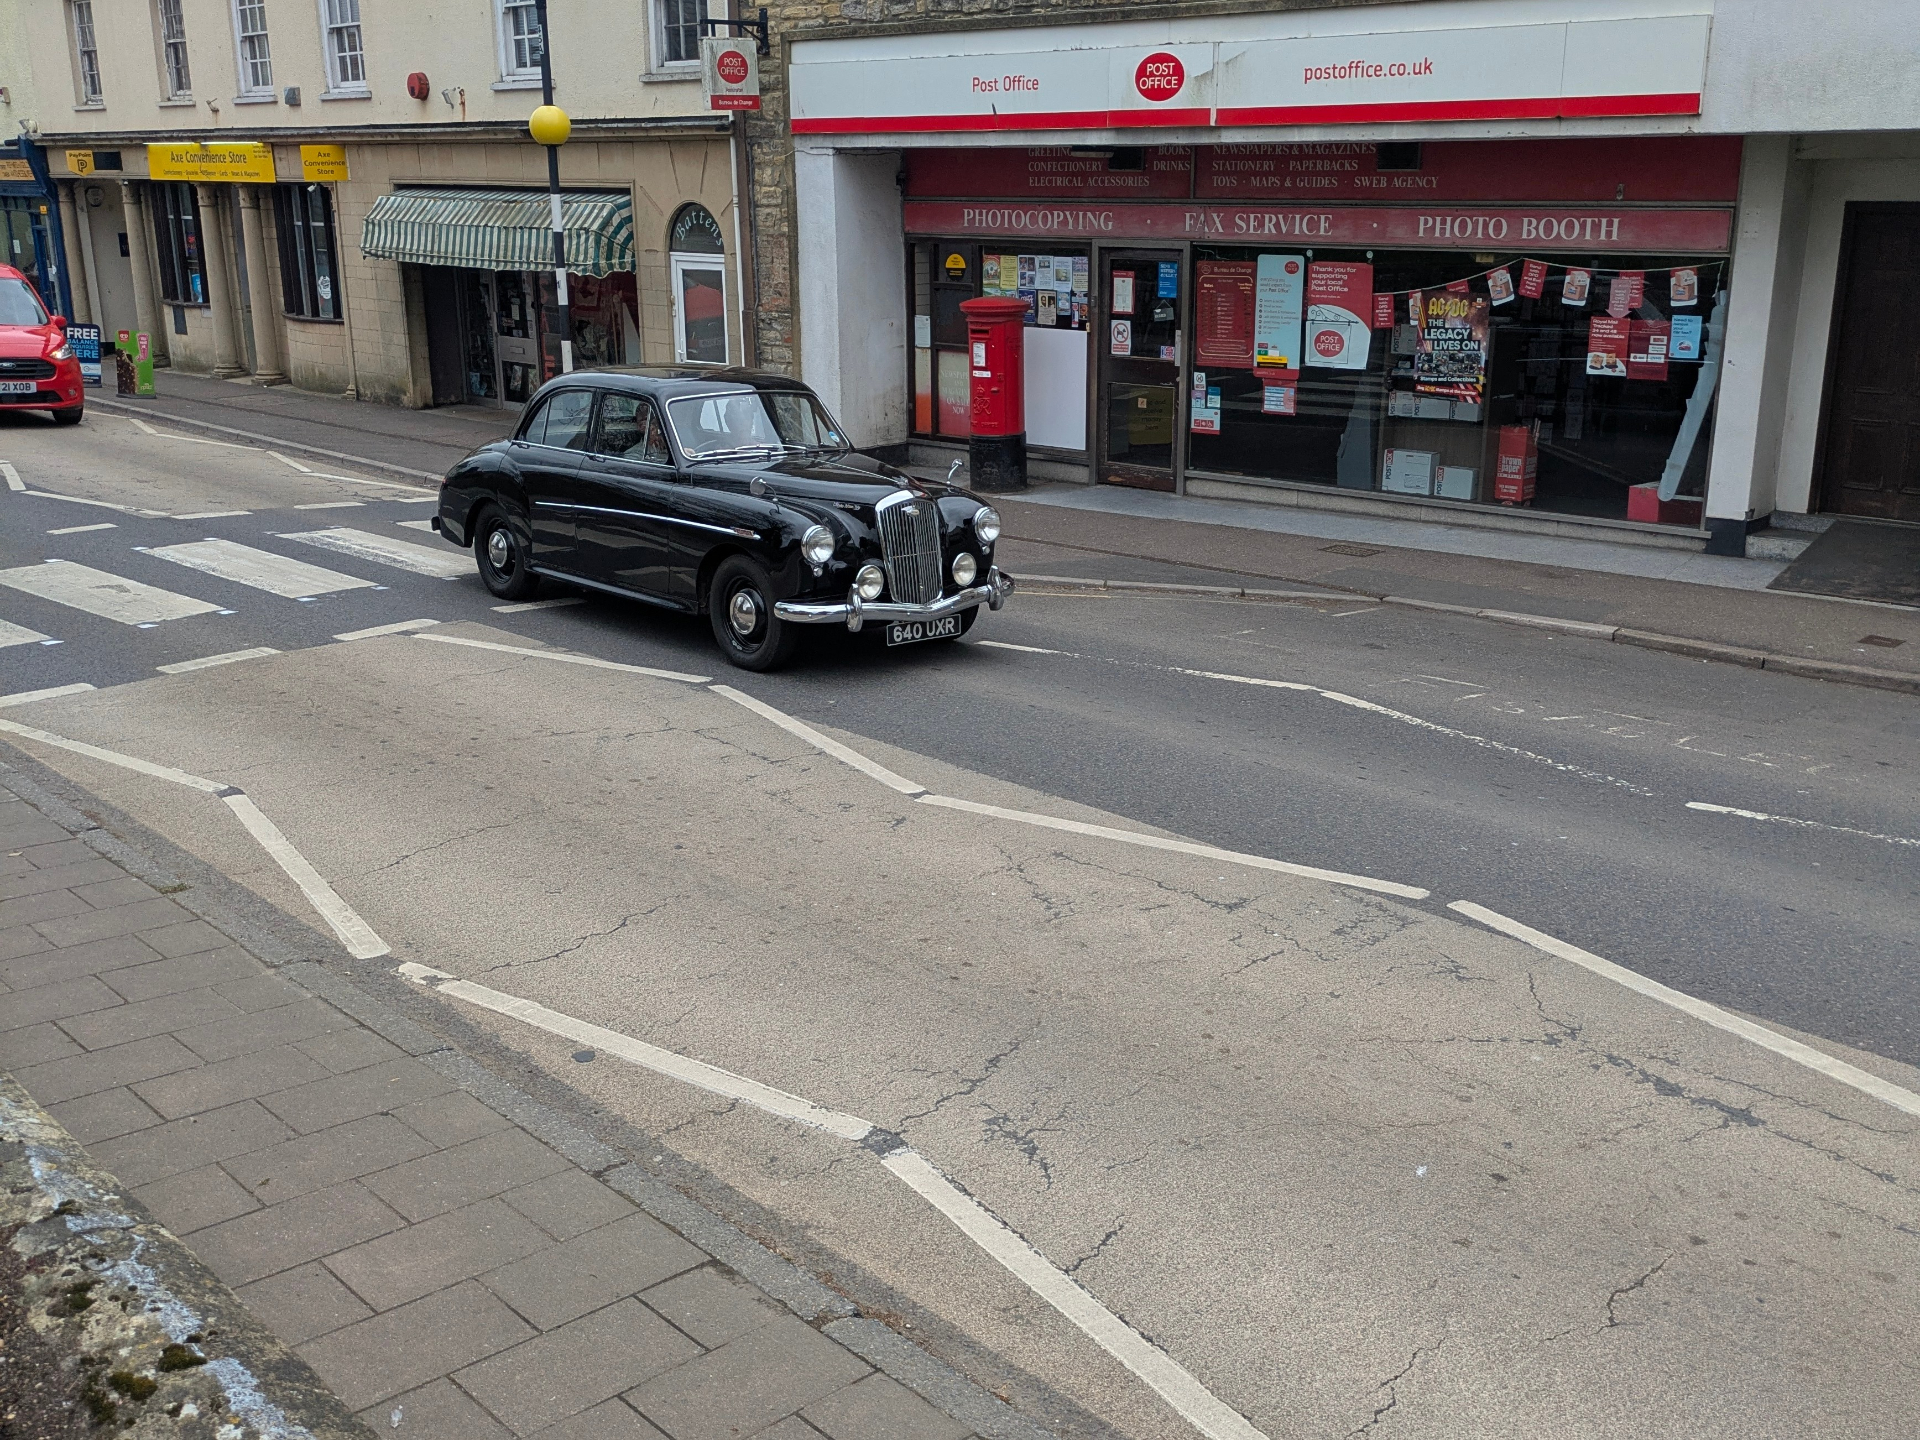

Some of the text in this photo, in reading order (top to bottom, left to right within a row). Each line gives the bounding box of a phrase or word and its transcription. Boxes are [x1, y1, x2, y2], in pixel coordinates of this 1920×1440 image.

[723, 57, 742, 66] POST
[720, 66, 746, 76] OFFICE
[1146, 62, 1174, 76] POST
[1303, 57, 1433, 85] postoffice.co.uk
[971, 74, 1040, 93] Post Office
[1139, 75, 1179, 90] OFFICE
[1158, 145, 1191, 155] BOOKS
[1212, 143, 1377, 155] NEWSPAPERS & MAGAZINES
[170, 151, 184, 163] Axe
[185, 151, 227, 163] Convenience
[228, 151, 247, 163] Store
[1028, 161, 1191, 172] CONFECTIONERY DRINKS
[1212, 160, 1359, 171] STATIONERY PAPERBACKS
[1029, 176, 1150, 187] ELECTRICAL ACCESSORIES
[1212, 176, 1439, 188] TOYS MAPS & GUIDES SWEB AGENCY
[675, 210, 723, 246] Battens
[962, 207, 1622, 241] PHOTOCOPYING FAX SERVICE PHOTO BOOTH
[66, 327, 98, 340] FREE
[1424, 329, 1470, 339] LEGACY
[1316, 343, 1340, 351] OFFICE
[1434, 341, 1478, 350] LIVES ON
[73, 350, 99, 358] ERE
[2, 383, 31, 391] 21 XOB
[947, 397, 955, 405] ON
[953, 406, 965, 414] NOW
[1385, 450, 1393, 480] POSTBOX
[1502, 456, 1522, 466] brown
[1501, 464, 1520, 473] paper
[1436, 467, 1444, 494] POSTBOX
[893, 618, 955, 642] 640 UXR
